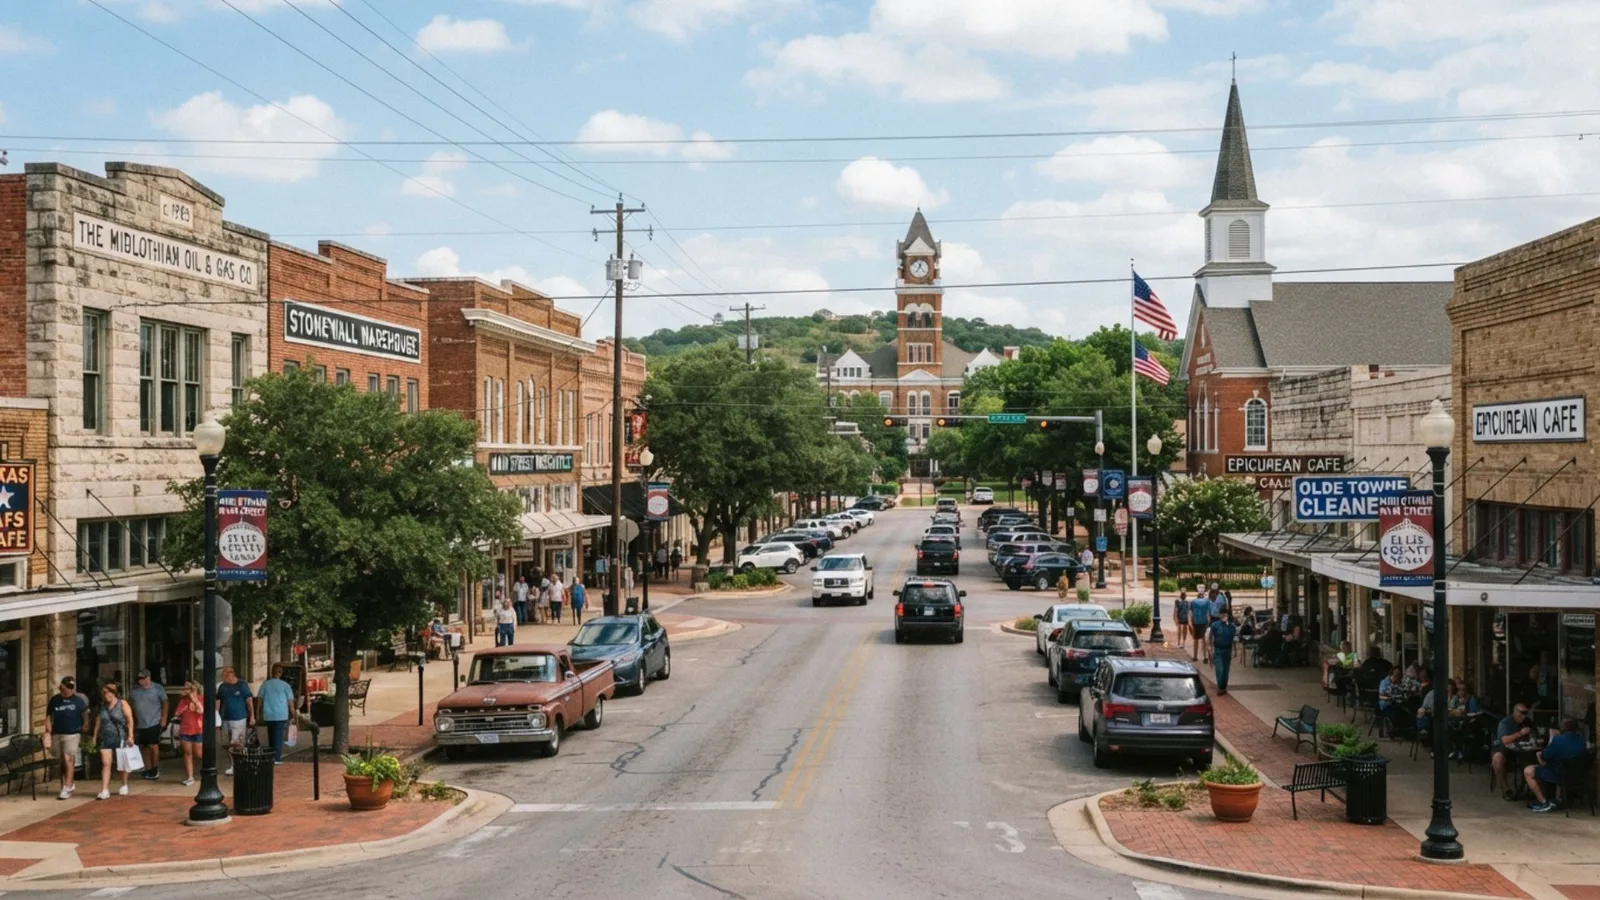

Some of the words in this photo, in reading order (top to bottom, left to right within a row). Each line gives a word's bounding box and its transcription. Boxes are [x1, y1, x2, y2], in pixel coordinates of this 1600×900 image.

[79, 220, 103, 248] THE
[184, 249, 201, 272] OIL
[216, 258, 235, 280] GAS
[239, 264, 252, 285] CO
[290, 309, 358, 345] STONEWALL
[1476, 408, 1537, 436] EPICUREAN
[1543, 405, 1577, 434] CAFE
[1228, 458, 1301, 472] EPICUREAN
[1307, 458, 1341, 471] CAFE
[1299, 481, 1343, 495] OLDE
